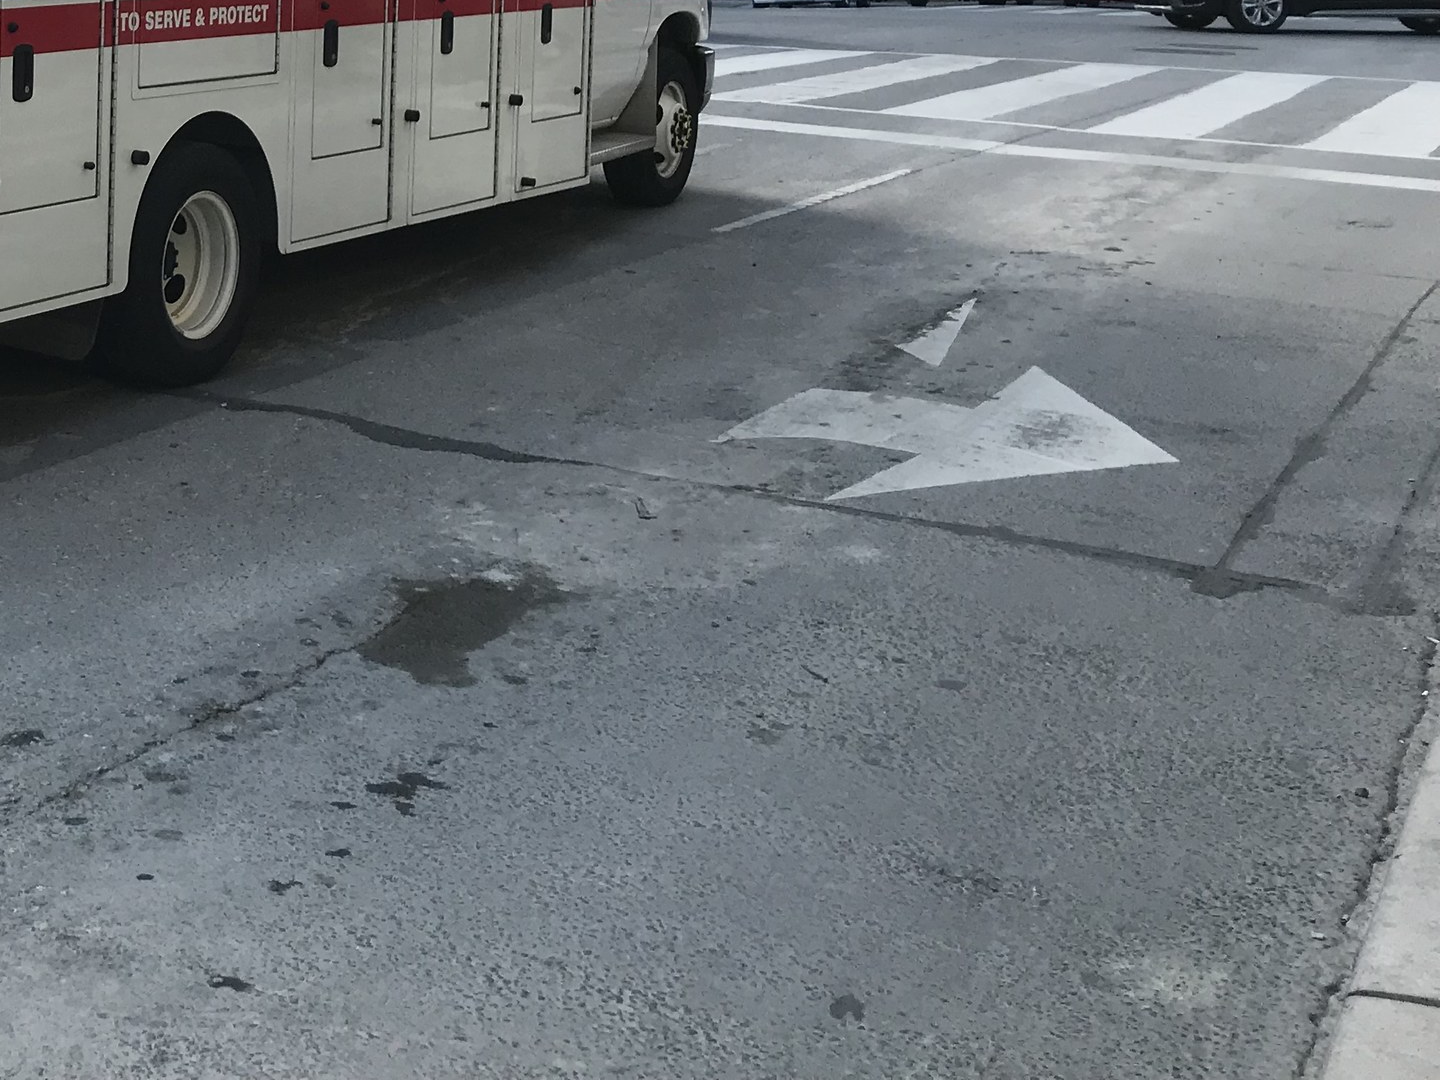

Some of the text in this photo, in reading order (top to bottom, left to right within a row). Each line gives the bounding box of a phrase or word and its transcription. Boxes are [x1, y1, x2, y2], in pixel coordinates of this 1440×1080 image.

[121, 3, 270, 32] TO SERVE & PROTECT
